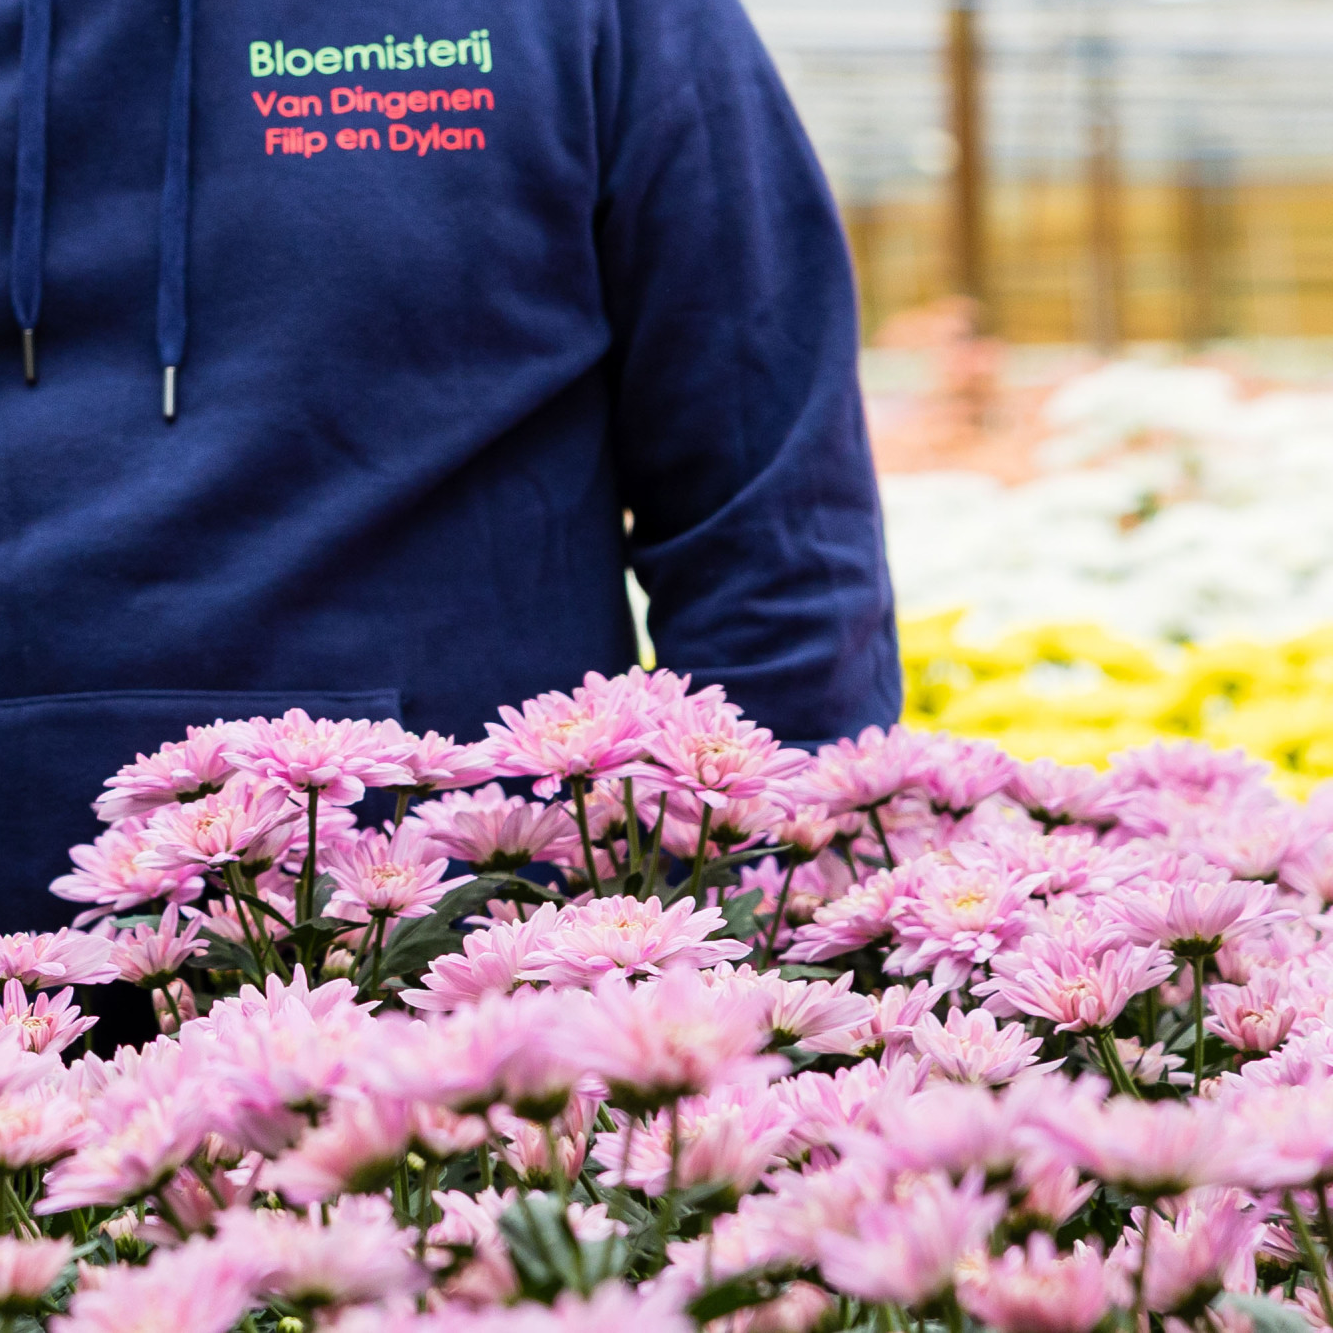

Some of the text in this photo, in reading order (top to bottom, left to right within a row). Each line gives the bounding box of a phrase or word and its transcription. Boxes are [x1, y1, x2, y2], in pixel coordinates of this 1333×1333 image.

[249, 29, 492, 77] Bloemisterij
[251, 85, 495, 120] Van Dingenen
[265, 122, 486, 158] Filip en Dylan
